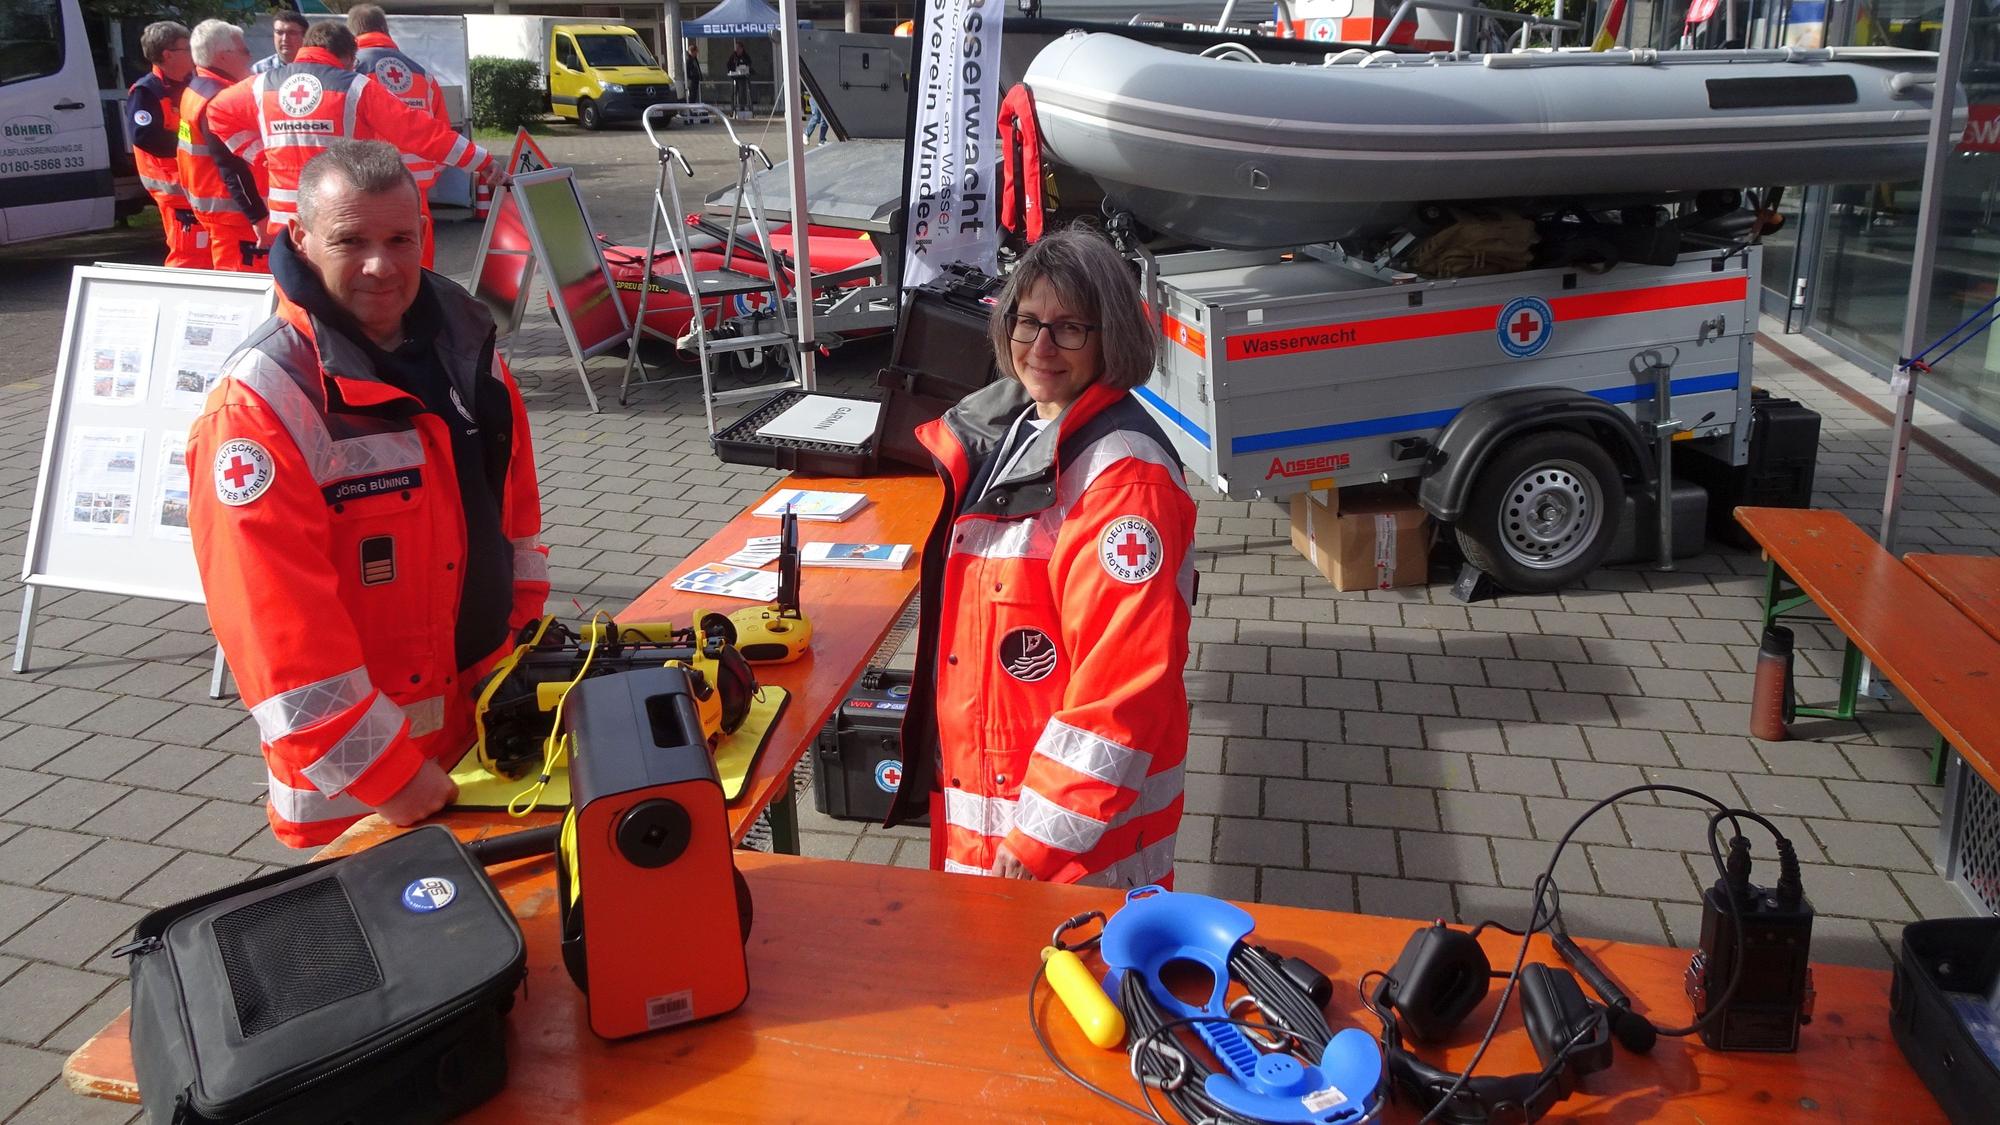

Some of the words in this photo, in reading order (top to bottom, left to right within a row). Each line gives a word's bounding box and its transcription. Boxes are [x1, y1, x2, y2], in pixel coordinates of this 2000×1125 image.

[4, 124, 53, 136] BÖHMER
[273, 121, 330, 131] Windeck
[0, 158, 61, 173] 0180-5868
[64, 157, 84, 168] 333
[915, 122, 938, 255] Windeck
[938, 153, 953, 236] Wasser.
[1243, 328, 1356, 353] Wasserwacht
[813, 406, 852, 431] GARMIN
[1265, 453, 1350, 480] Anssems
[242, 469, 267, 498] KREUZ
[336, 482, 366, 498] JÖRG
[370, 476, 410, 491] BÜNING
[1107, 521, 1155, 544] DEUTSCHES
[1106, 552, 1131, 578] ROTES
[1134, 551, 1157, 578] KREUZ
